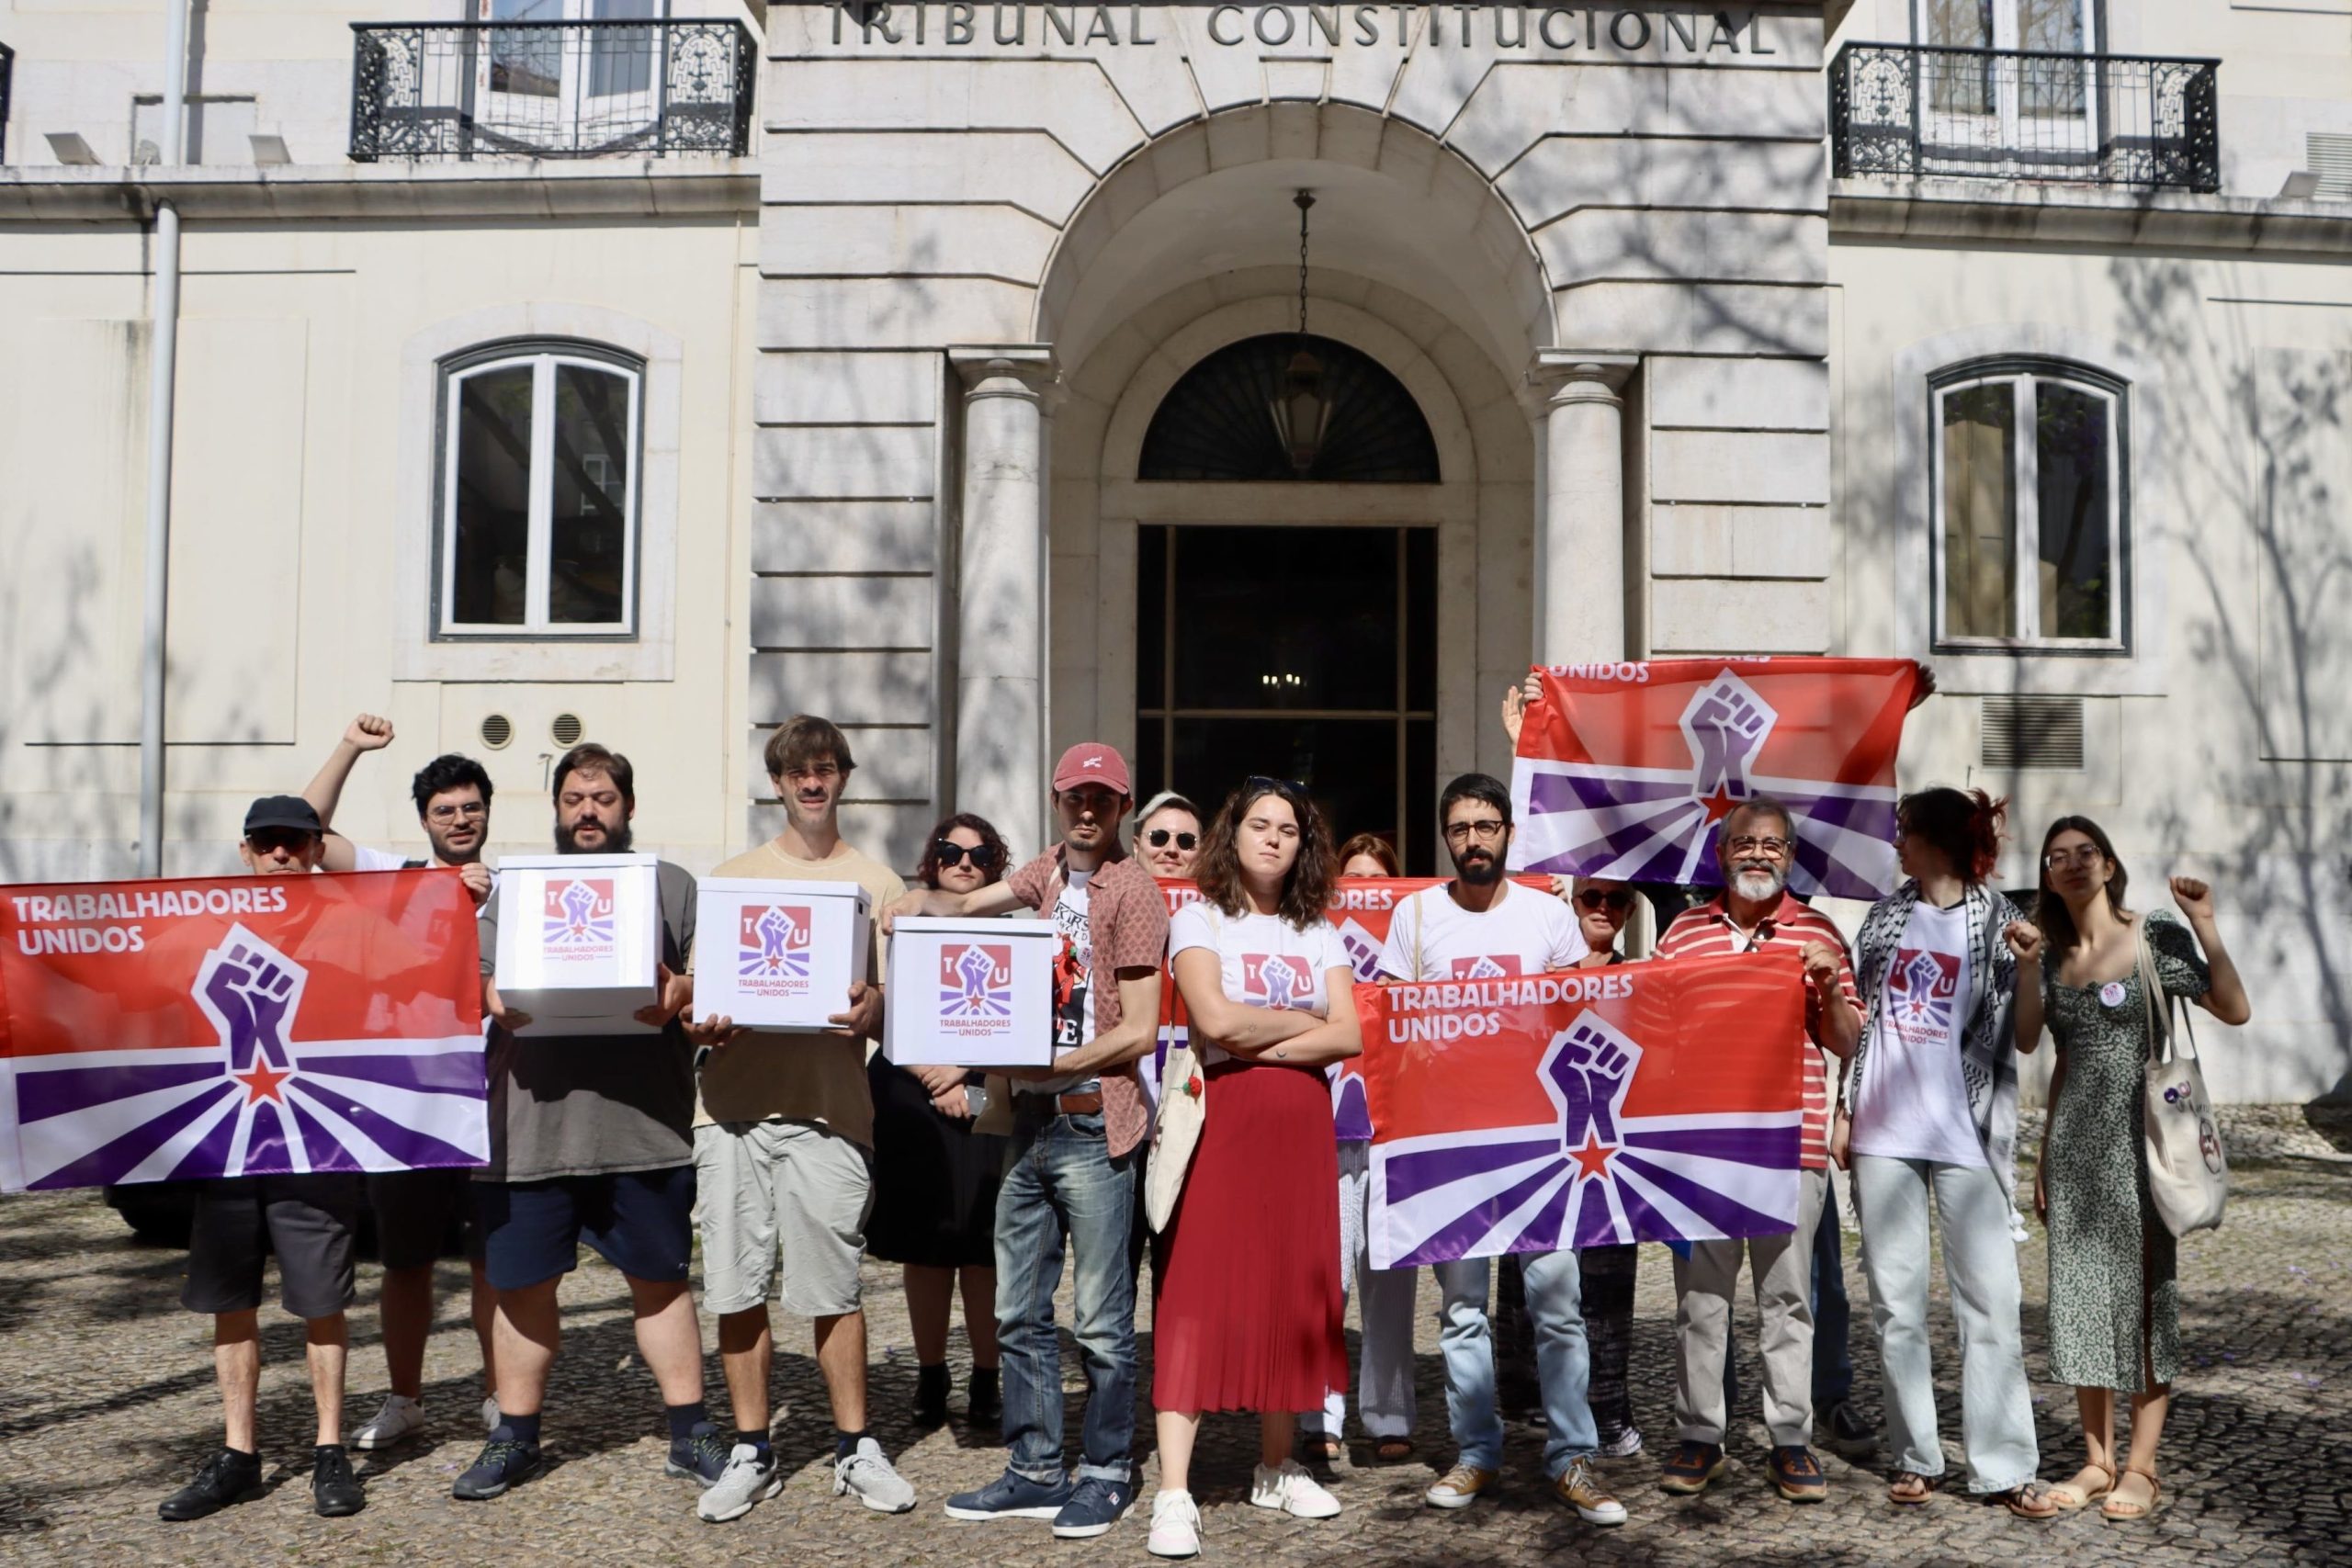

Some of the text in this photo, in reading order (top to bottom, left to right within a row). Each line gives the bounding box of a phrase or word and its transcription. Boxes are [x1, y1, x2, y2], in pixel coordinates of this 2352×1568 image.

[824, 3, 1775, 54] TRIBUNAL CONSTITUCIONAL
[12, 886, 287, 921] TRABALHADORES
[18, 926, 144, 955] UNIDOS
[544, 945, 614, 953] TRABALHADORES
[739, 979, 808, 988] TRABALHADORES
[756, 988, 789, 997] UNIDOS
[1387, 974, 1634, 1011] TRABALHADORES
[940, 1019, 1011, 1028] TRABALHADORES
[1388, 1012, 1499, 1043] UNIDOS
[958, 1028, 991, 1036] UNIDOS
[1900, 1033, 1928, 1044] NIDOS
